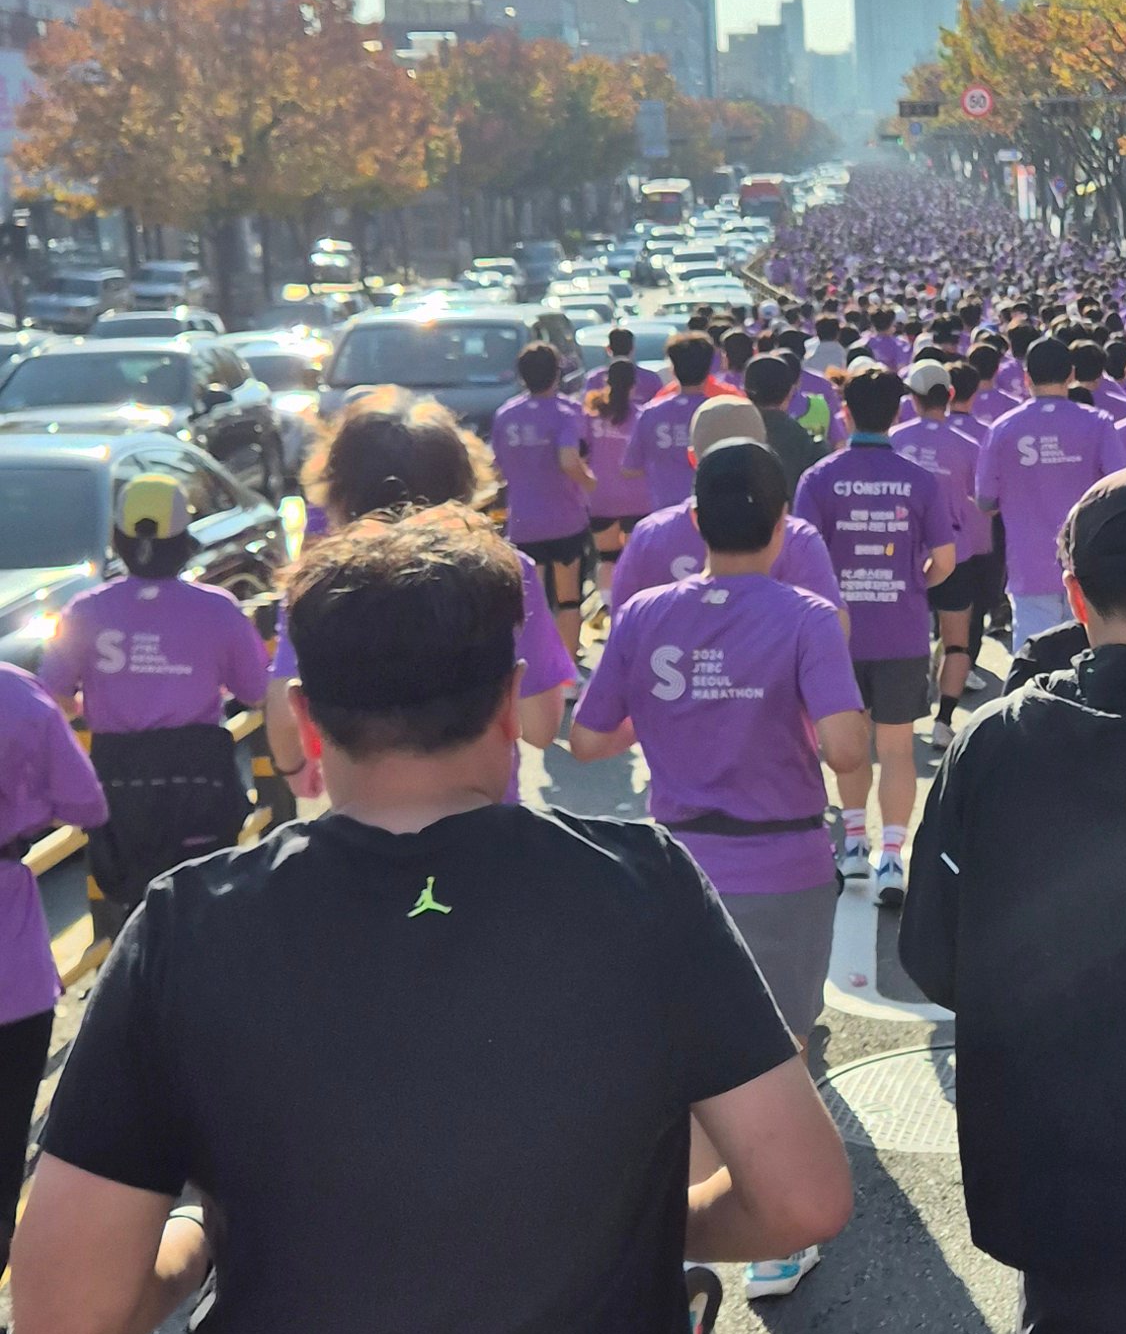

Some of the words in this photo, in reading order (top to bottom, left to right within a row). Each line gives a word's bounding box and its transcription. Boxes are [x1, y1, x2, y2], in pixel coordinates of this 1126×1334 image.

[853, 481, 912, 497] ONSTYLE
[692, 649, 724, 660] 2024
[692, 675, 732, 687] SEOUL
[691, 688, 764, 699] MARATHON
